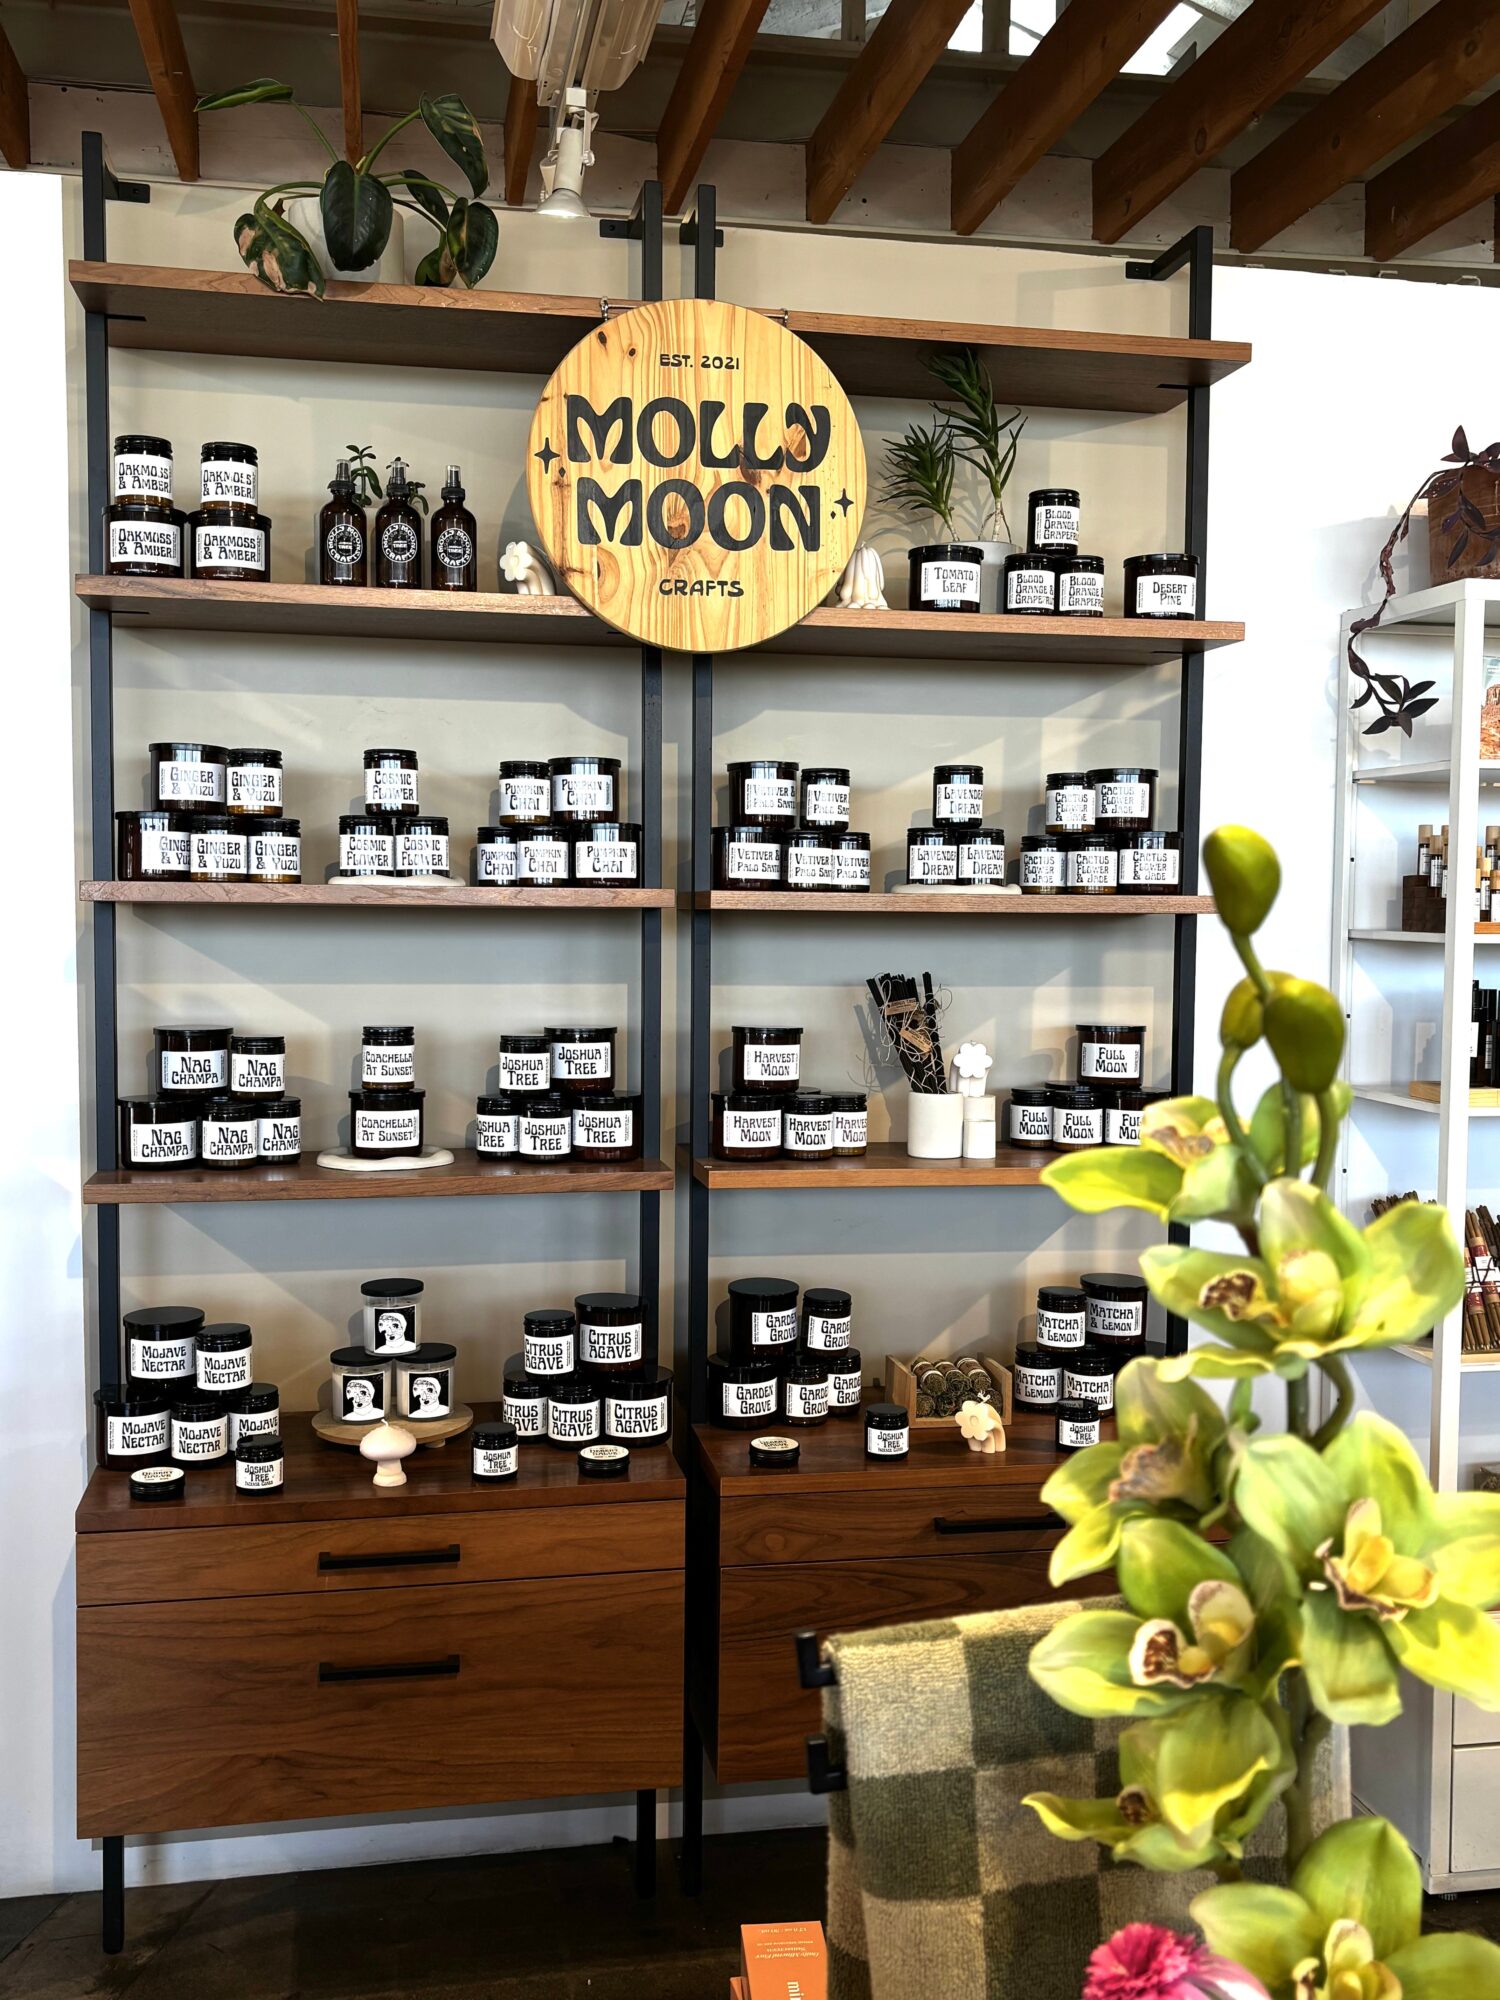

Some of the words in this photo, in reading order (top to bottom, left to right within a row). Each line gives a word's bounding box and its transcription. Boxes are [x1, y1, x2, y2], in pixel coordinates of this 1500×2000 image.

[660, 354, 693, 367] EST.
[701, 356, 739, 370] 2021
[566, 394, 830, 472] MOLLY
[119, 462, 169, 480] OAKMOSS
[119, 476, 126, 490] &
[132, 476, 169, 493] AMBER
[203, 484, 209, 496] &
[215, 483, 251, 498] AMBER
[577, 477, 821, 552] MOON
[1045, 509, 1071, 519] BLOOD
[1044, 520, 1075, 530] ORANGE
[119, 529, 172, 545] OAKMOSS
[204, 533, 256, 549] OAKMOSS
[119, 542, 128, 555] &
[134, 542, 172, 559] AMBER
[204, 547, 212, 559] &
[219, 547, 256, 562] AMBER
[934, 567, 974, 581] TOMATO
[1017, 574, 1043, 584] BLOOD
[1070, 576, 1096, 586] BLOOD
[659, 579, 744, 597] CRAFTS
[942, 580, 968, 593] LEAF
[1016, 584, 1047, 594] ORANGE
[1069, 587, 1099, 596] ORANGE
[1153, 582, 1187, 594] DESERT
[1160, 593, 1182, 606] PINE
[170, 766, 214, 784] GINGER
[232, 772, 275, 788] GINGER
[233, 789, 241, 801] &
[510, 795, 539, 810] CHAI
[197, 839, 241, 855] GINGER
[255, 841, 298, 857] GINGER
[349, 837, 386, 851] COSMIC
[404, 837, 440, 851] COSMIC
[347, 851, 388, 866] FLOWER
[402, 852, 443, 866] FLOWER
[737, 849, 773, 860] VETIVER
[795, 853, 829, 865] VETIVER
[1024, 854, 1055, 865] CACTUS
[1076, 854, 1110, 865] CACTUS
[1133, 851, 1167, 862] CACTUS
[198, 856, 207, 868] &
[214, 857, 241, 869] YUZU
[256, 857, 265, 870] &
[272, 858, 298, 871] YUZU
[485, 861, 513, 875] CHAI
[529, 858, 557, 873] CHAI
[592, 858, 623, 873] CHAI
[737, 862, 759, 872] PALO
[922, 862, 954, 876] DREAM
[1133, 871, 1141, 880] &
[1145, 872, 1166, 880] JADE
[365, 1051, 413, 1063] COACHELLA
[559, 1046, 601, 1061] JOSHUA
[754, 1051, 795, 1063] HARVEST
[1099, 1047, 1125, 1060] FULL
[181, 1057, 211, 1073] NAG
[247, 1060, 276, 1076] NAG
[366, 1064, 377, 1076] AT
[381, 1065, 412, 1076] SUNSET
[502, 1057, 543, 1071] JOSHUA
[564, 1060, 597, 1075] TREE
[761, 1064, 790, 1076] MOON
[1095, 1059, 1127, 1073] MOON
[172, 1071, 219, 1084] CHAMPA
[239, 1074, 281, 1087] CHAMPA
[507, 1071, 539, 1086] TREE
[362, 1117, 413, 1128] COACHELLA
[579, 1114, 621, 1129] JOSHUA
[734, 1116, 776, 1129] HARVEST
[1022, 1110, 1048, 1122] FULL
[1065, 1113, 1092, 1126] FULL
[272, 1123, 298, 1140] NAG
[524, 1122, 566, 1136] JOSHUA
[789, 1118, 831, 1131] HARVEST
[1019, 1122, 1050, 1136] MOON
[151, 1129, 182, 1146] NAG
[218, 1127, 248, 1144] NAG
[362, 1131, 375, 1141] AT
[379, 1131, 413, 1141] SUNSET
[584, 1128, 616, 1143] TREE
[740, 1129, 771, 1142] MOON
[795, 1132, 826, 1145] MOON
[1063, 1126, 1094, 1139] MOON
[478, 1132, 504, 1148] TREE
[530, 1136, 562, 1151] TREE
[142, 1144, 189, 1158] CHAMPA
[210, 1142, 253, 1156] CHAMPA
[1090, 1303, 1133, 1319] MATCHA
[1038, 1312, 1079, 1330] MATCHA
[1091, 1317, 1097, 1328] &
[1102, 1319, 1132, 1331] LEMON
[589, 1329, 632, 1345] CITRUS
[770, 1326, 796, 1342] GROVE
[1039, 1327, 1044, 1338] &
[1048, 1330, 1077, 1342] LEMON
[142, 1345, 186, 1359] MOJAVE
[526, 1338, 563, 1357] CITRUS
[589, 1344, 632, 1359] AGAVE
[142, 1358, 186, 1372] NECTAR
[204, 1356, 246, 1370] MOJAVE
[525, 1355, 563, 1370] AGAVE
[204, 1369, 246, 1384] NECTAR
[1015, 1368, 1055, 1386] MATCHA
[1067, 1376, 1109, 1393] MATCHA
[736, 1385, 774, 1400] GARDEN
[1025, 1386, 1054, 1398] LEMON
[552, 1405, 593, 1423] CITRUS
[614, 1403, 658, 1419] CITRUS
[740, 1400, 771, 1415] GROVE
[122, 1419, 166, 1435] MOJAVE
[239, 1416, 278, 1432] MOJAVE
[552, 1421, 593, 1437] AGAVE
[615, 1419, 658, 1434] AGAVE
[1070, 1424, 1095, 1432] JOSHUA
[179, 1426, 221, 1440] MOJAVE
[878, 1431, 903, 1440] JOSHUA
[1074, 1431, 1092, 1440] TREE
[122, 1433, 165, 1449] NECTAR
[179, 1439, 221, 1454] NECTAR
[882, 1439, 900, 1448] TREE
[483, 1451, 511, 1460] JOSHUA
[245, 1464, 274, 1473] JOSHUA
[488, 1459, 507, 1468] TREE
[249, 1472, 269, 1481] TREE
